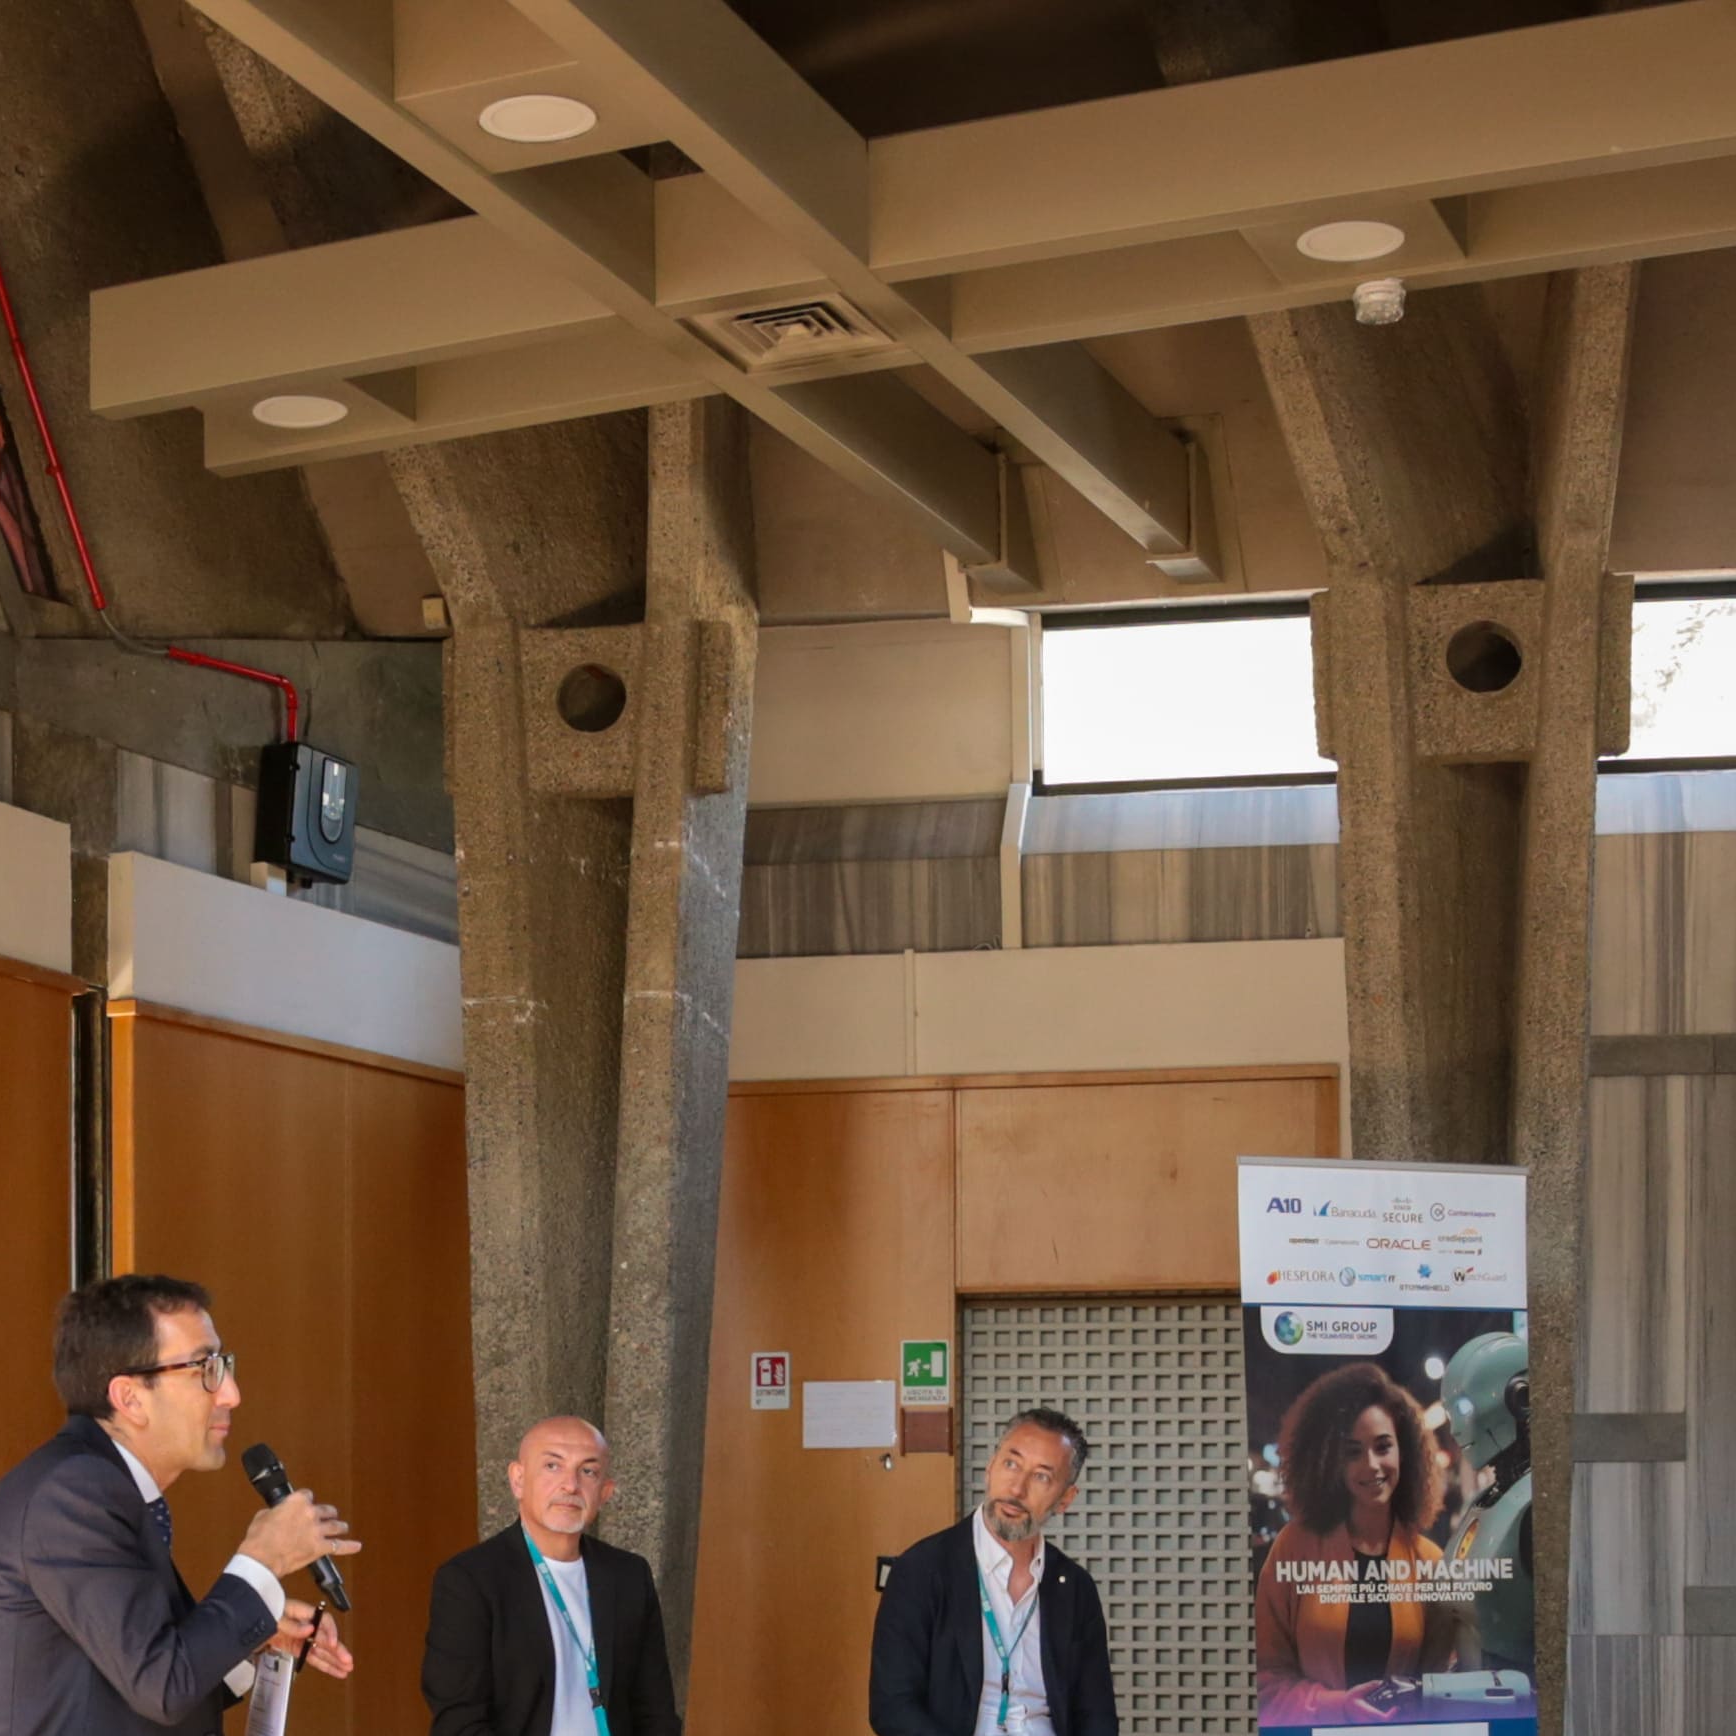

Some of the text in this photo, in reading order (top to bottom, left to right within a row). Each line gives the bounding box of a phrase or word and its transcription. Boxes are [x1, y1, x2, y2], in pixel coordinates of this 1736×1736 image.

[1266, 1197, 1302, 1213] A10
[1382, 1212, 1424, 1224] SECURE
[1366, 1238, 1432, 1251] ORACLE
[1278, 1270, 1336, 1282] HESPLORA
[1306, 1320, 1378, 1333] SMI GROUP
[1276, 1558, 1513, 1582] HUMAN AND MACHINE
[1317, 1583, 1358, 1594] SEMPRE
[1377, 1582, 1414, 1593] CHIAVE
[1415, 1582, 1434, 1593] PER
[1436, 1582, 1452, 1592] UN
[1453, 1581, 1493, 1592] FUTURO
[1319, 1593, 1366, 1604] DIGITALE
[1367, 1593, 1404, 1603] SICURO
[1414, 1592, 1475, 1602] INNOVATIVO
